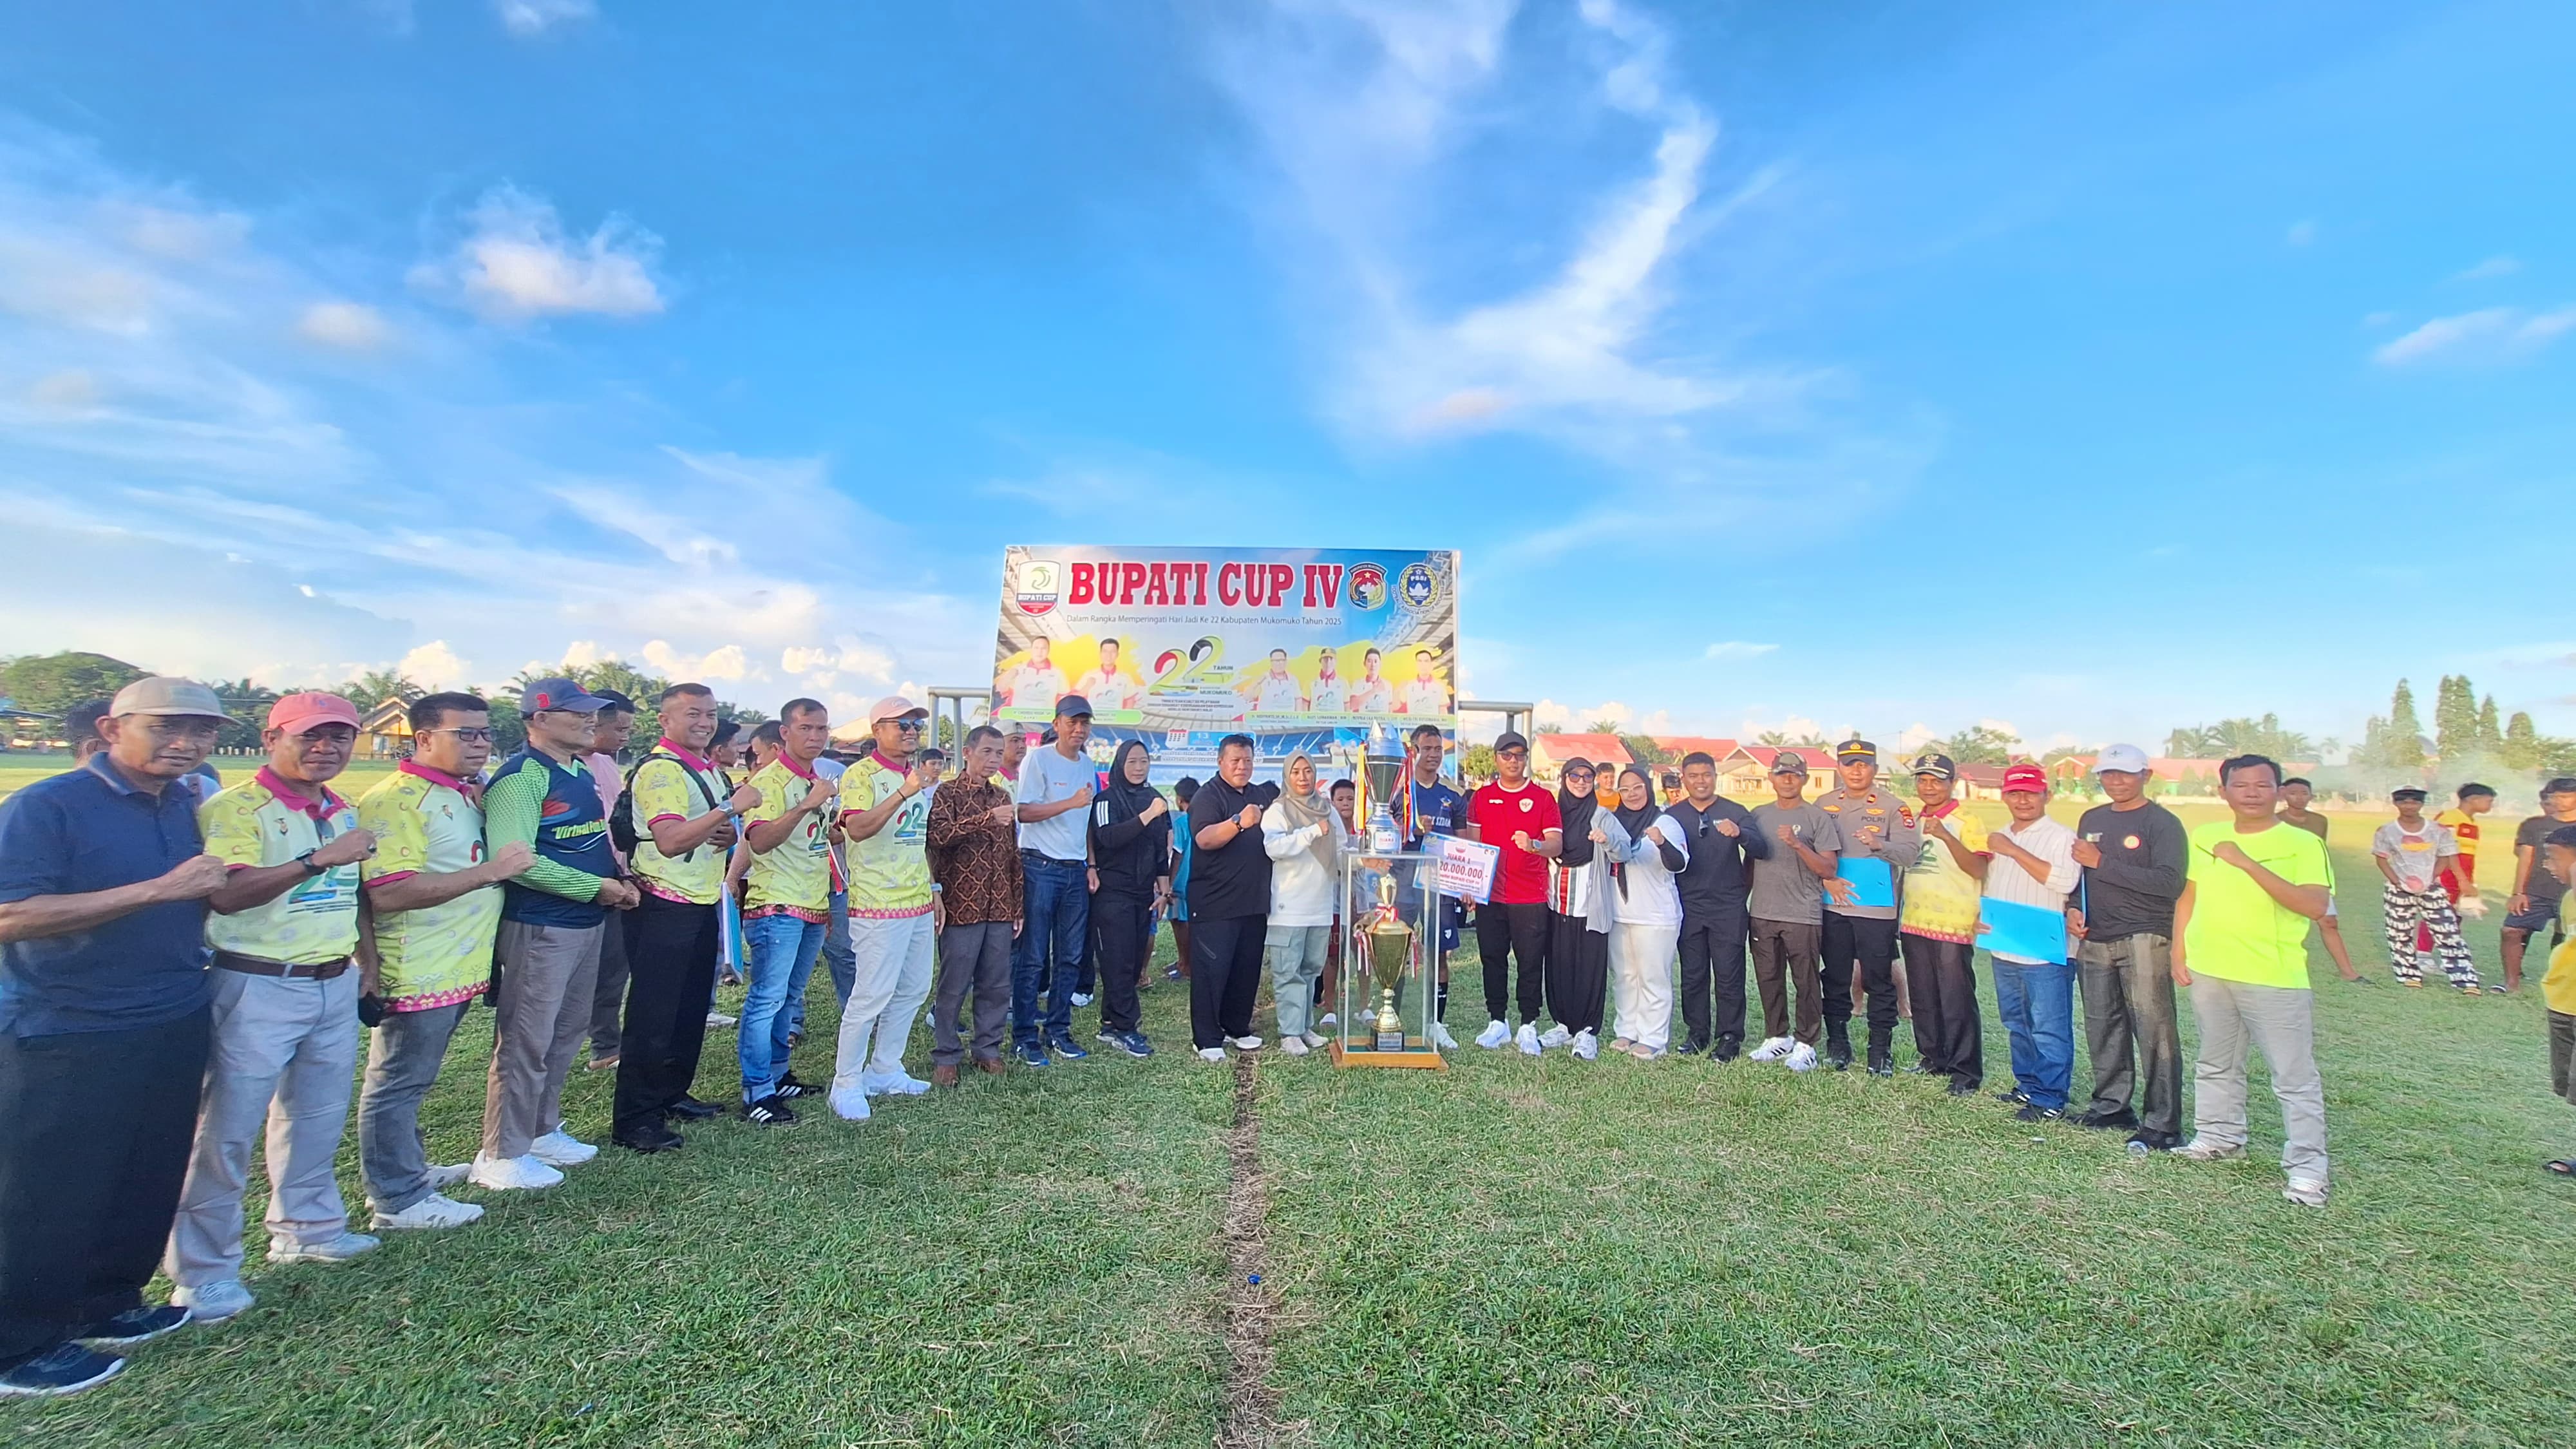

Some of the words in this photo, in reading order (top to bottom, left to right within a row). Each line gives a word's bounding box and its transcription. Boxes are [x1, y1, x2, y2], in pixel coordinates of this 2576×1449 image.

[1068, 562, 1208, 605] BUPATI
[1217, 563, 1294, 607] CUP
[1302, 565, 1343, 608] IV
[1090, 615, 1116, 624] Rangka
[1118, 615, 1167, 624] Memperingati
[1220, 616, 1258, 625] Kabupaten
[1260, 616, 1300, 625] Mukomuko
[536, 693, 551, 708] 3
[1446, 853, 1466, 864] JUARA
